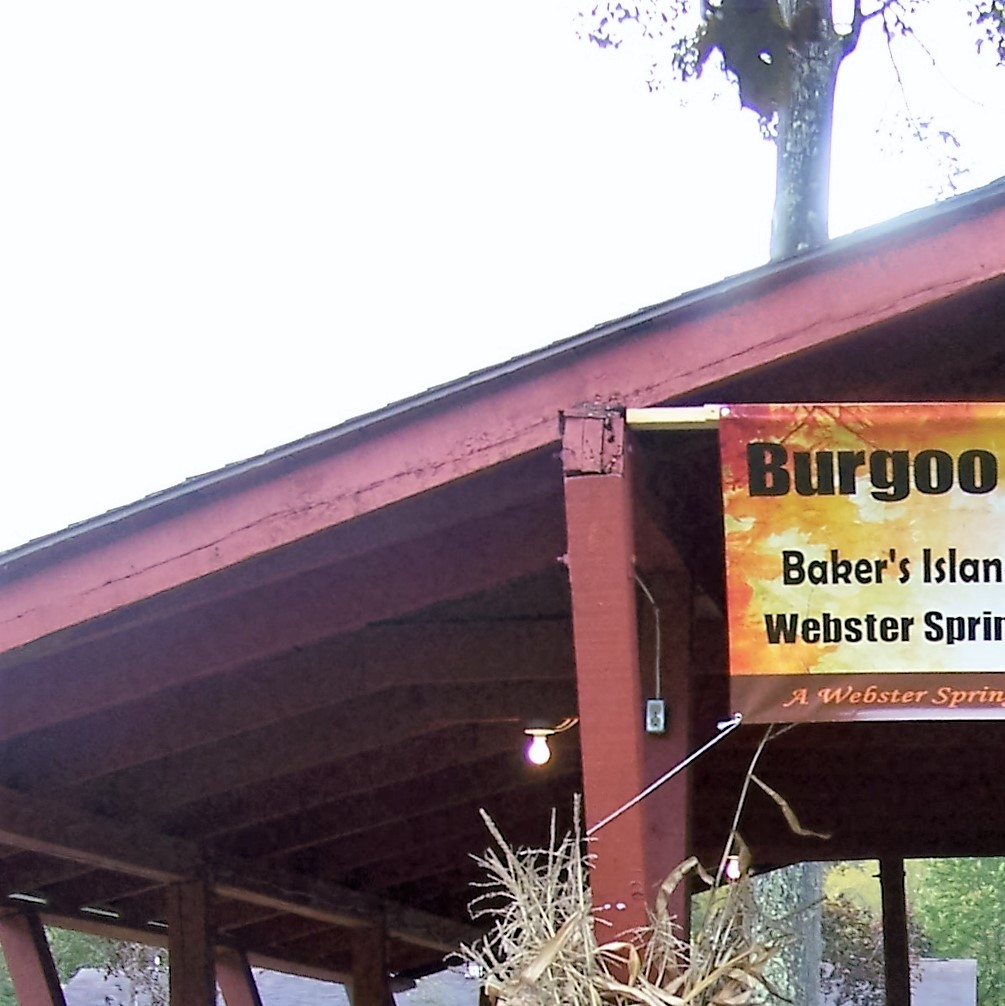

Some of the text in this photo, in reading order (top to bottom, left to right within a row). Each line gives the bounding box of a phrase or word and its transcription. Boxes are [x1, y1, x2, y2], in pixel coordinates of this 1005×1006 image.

[746, 440, 999, 503] Burgoo
[781, 549, 911, 586] Baker's
[765, 612, 914, 644] Webster
[783, 687, 810, 707] A
[817, 685, 928, 705] Webster
